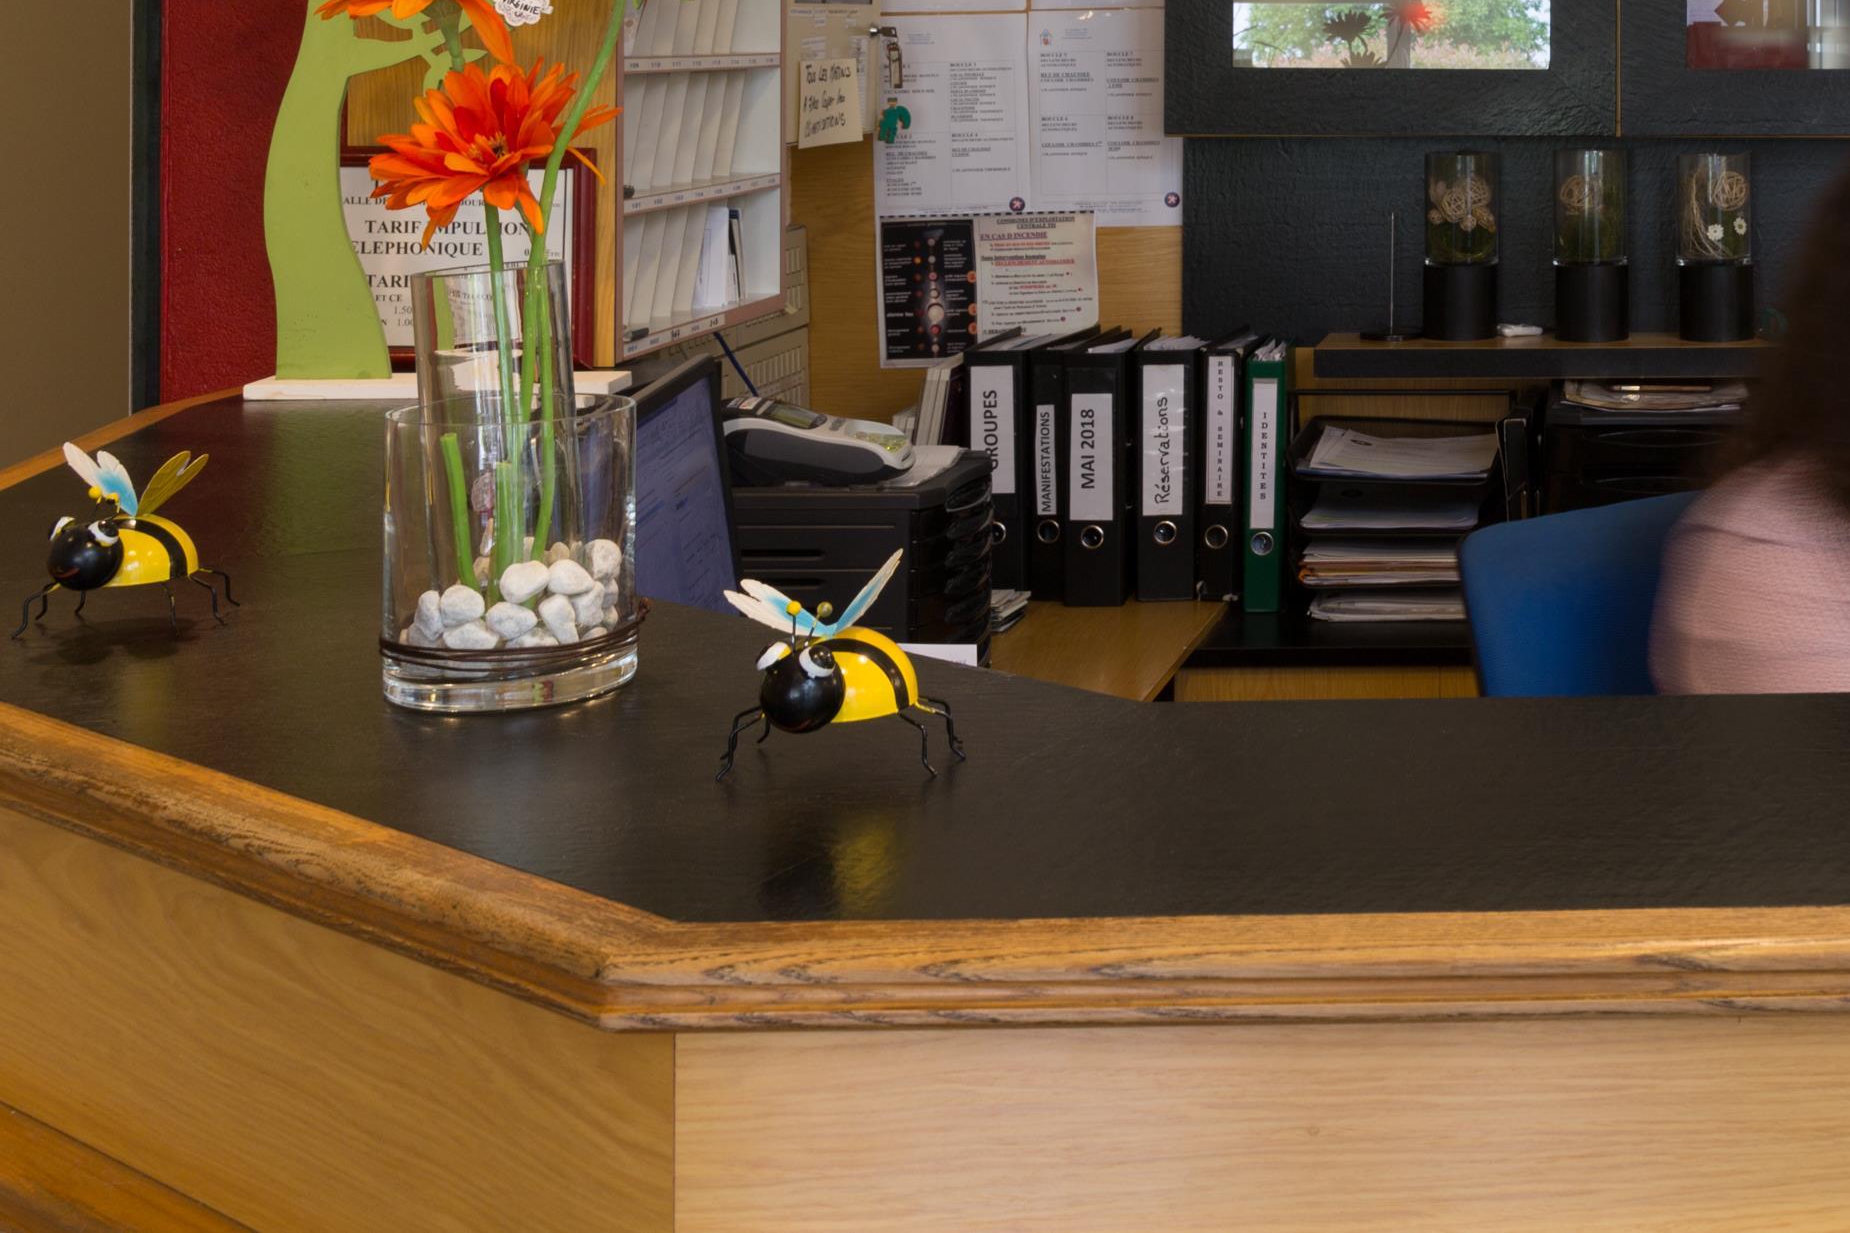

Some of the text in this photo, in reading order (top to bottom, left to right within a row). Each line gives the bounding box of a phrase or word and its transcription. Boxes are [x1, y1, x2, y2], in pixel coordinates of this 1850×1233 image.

[352, 241, 483, 258] ELEPHONIQUE
[365, 220, 529, 235] TARIF MPULION
[367, 274, 409, 288] TARI
[1040, 411, 1051, 513] MANIFESTATIONS
[1081, 409, 1095, 489] MAI 2018
[1154, 397, 1170, 504] Réservations
[1260, 412, 1268, 500] IDENTITES
